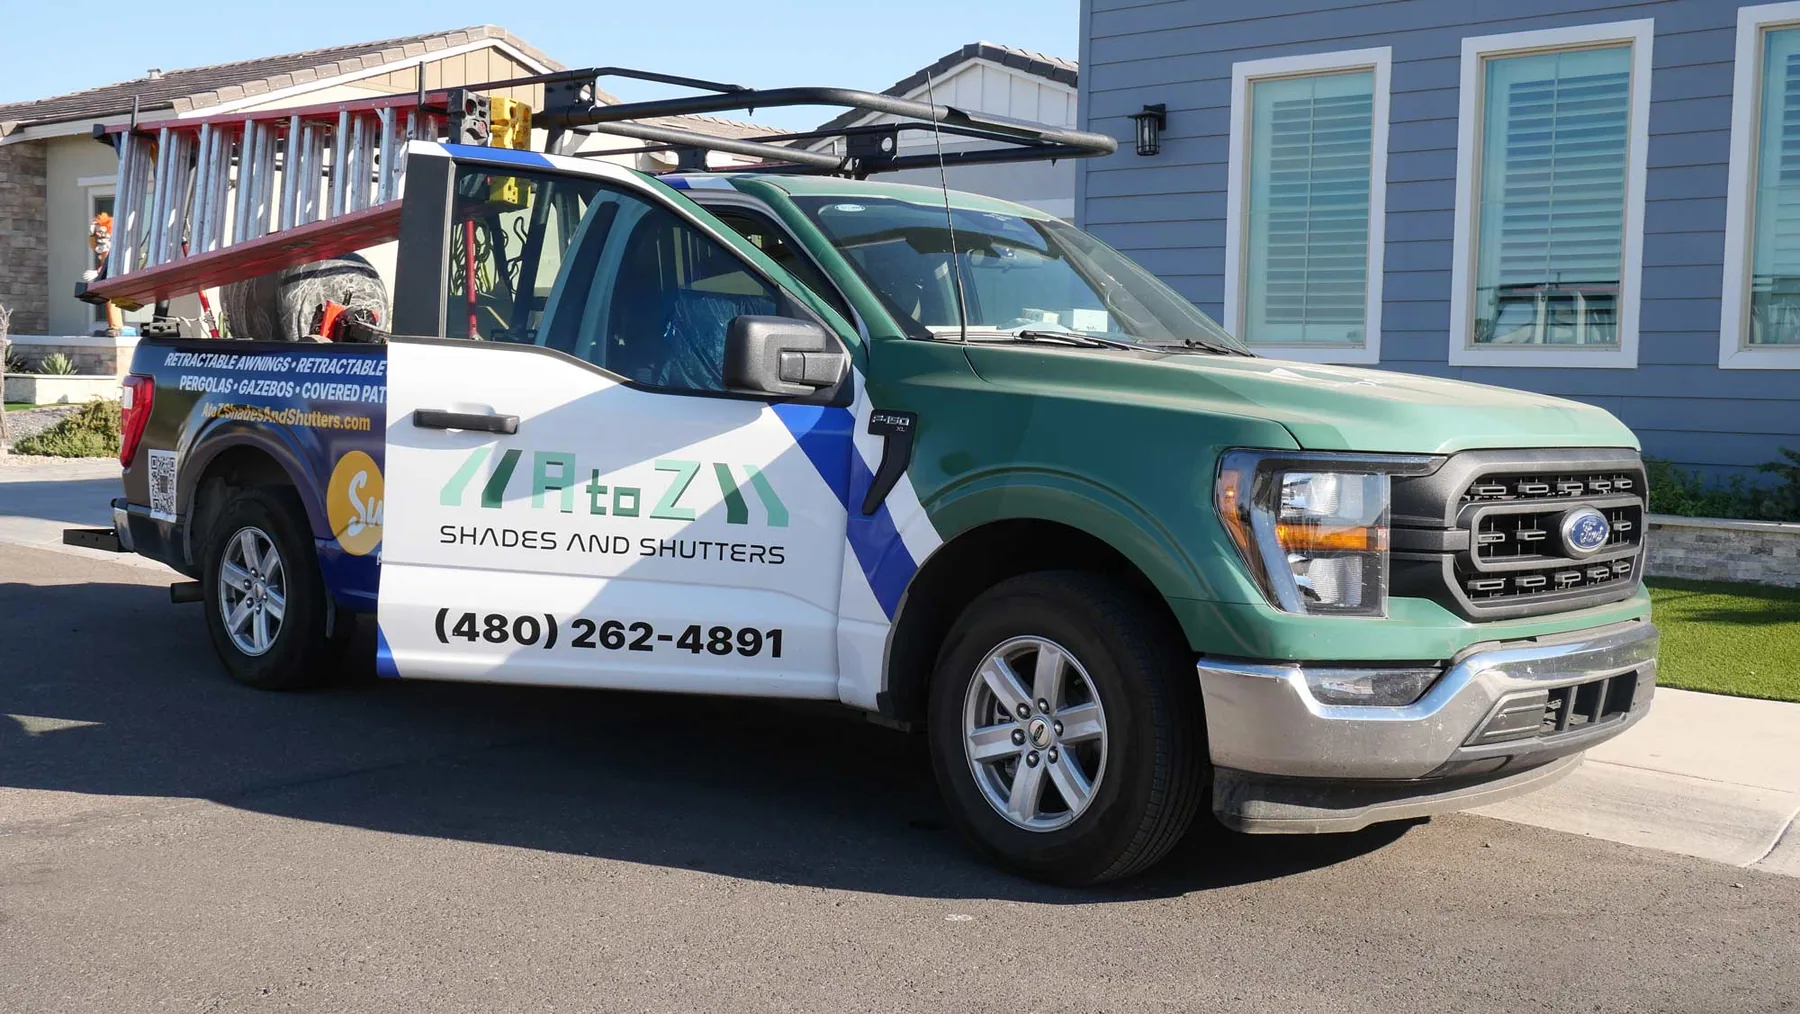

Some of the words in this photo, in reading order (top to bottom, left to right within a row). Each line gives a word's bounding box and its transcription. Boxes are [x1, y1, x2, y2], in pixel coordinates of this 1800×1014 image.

[164, 352, 239, 370] RETRACTABLE
[235, 355, 292, 372] AWNINGS
[295, 358, 387, 376] RETRACTABLE
[180, 375, 234, 394] PERGOLAS
[238, 379, 295, 398] GAZEBOS
[302, 382, 361, 402] COVERED
[362, 385, 387, 403] PAT
[201, 402, 371, 431] AtoZShadesAndShutters.com
[439, 525, 557, 551] SHADES
[566, 532, 630, 555] AND
[639, 537, 785, 565] SHUTTERS
[1580, 520, 1604, 543] Ford
[434, 607, 559, 650] (480)
[570, 617, 784, 659] 262-4891
